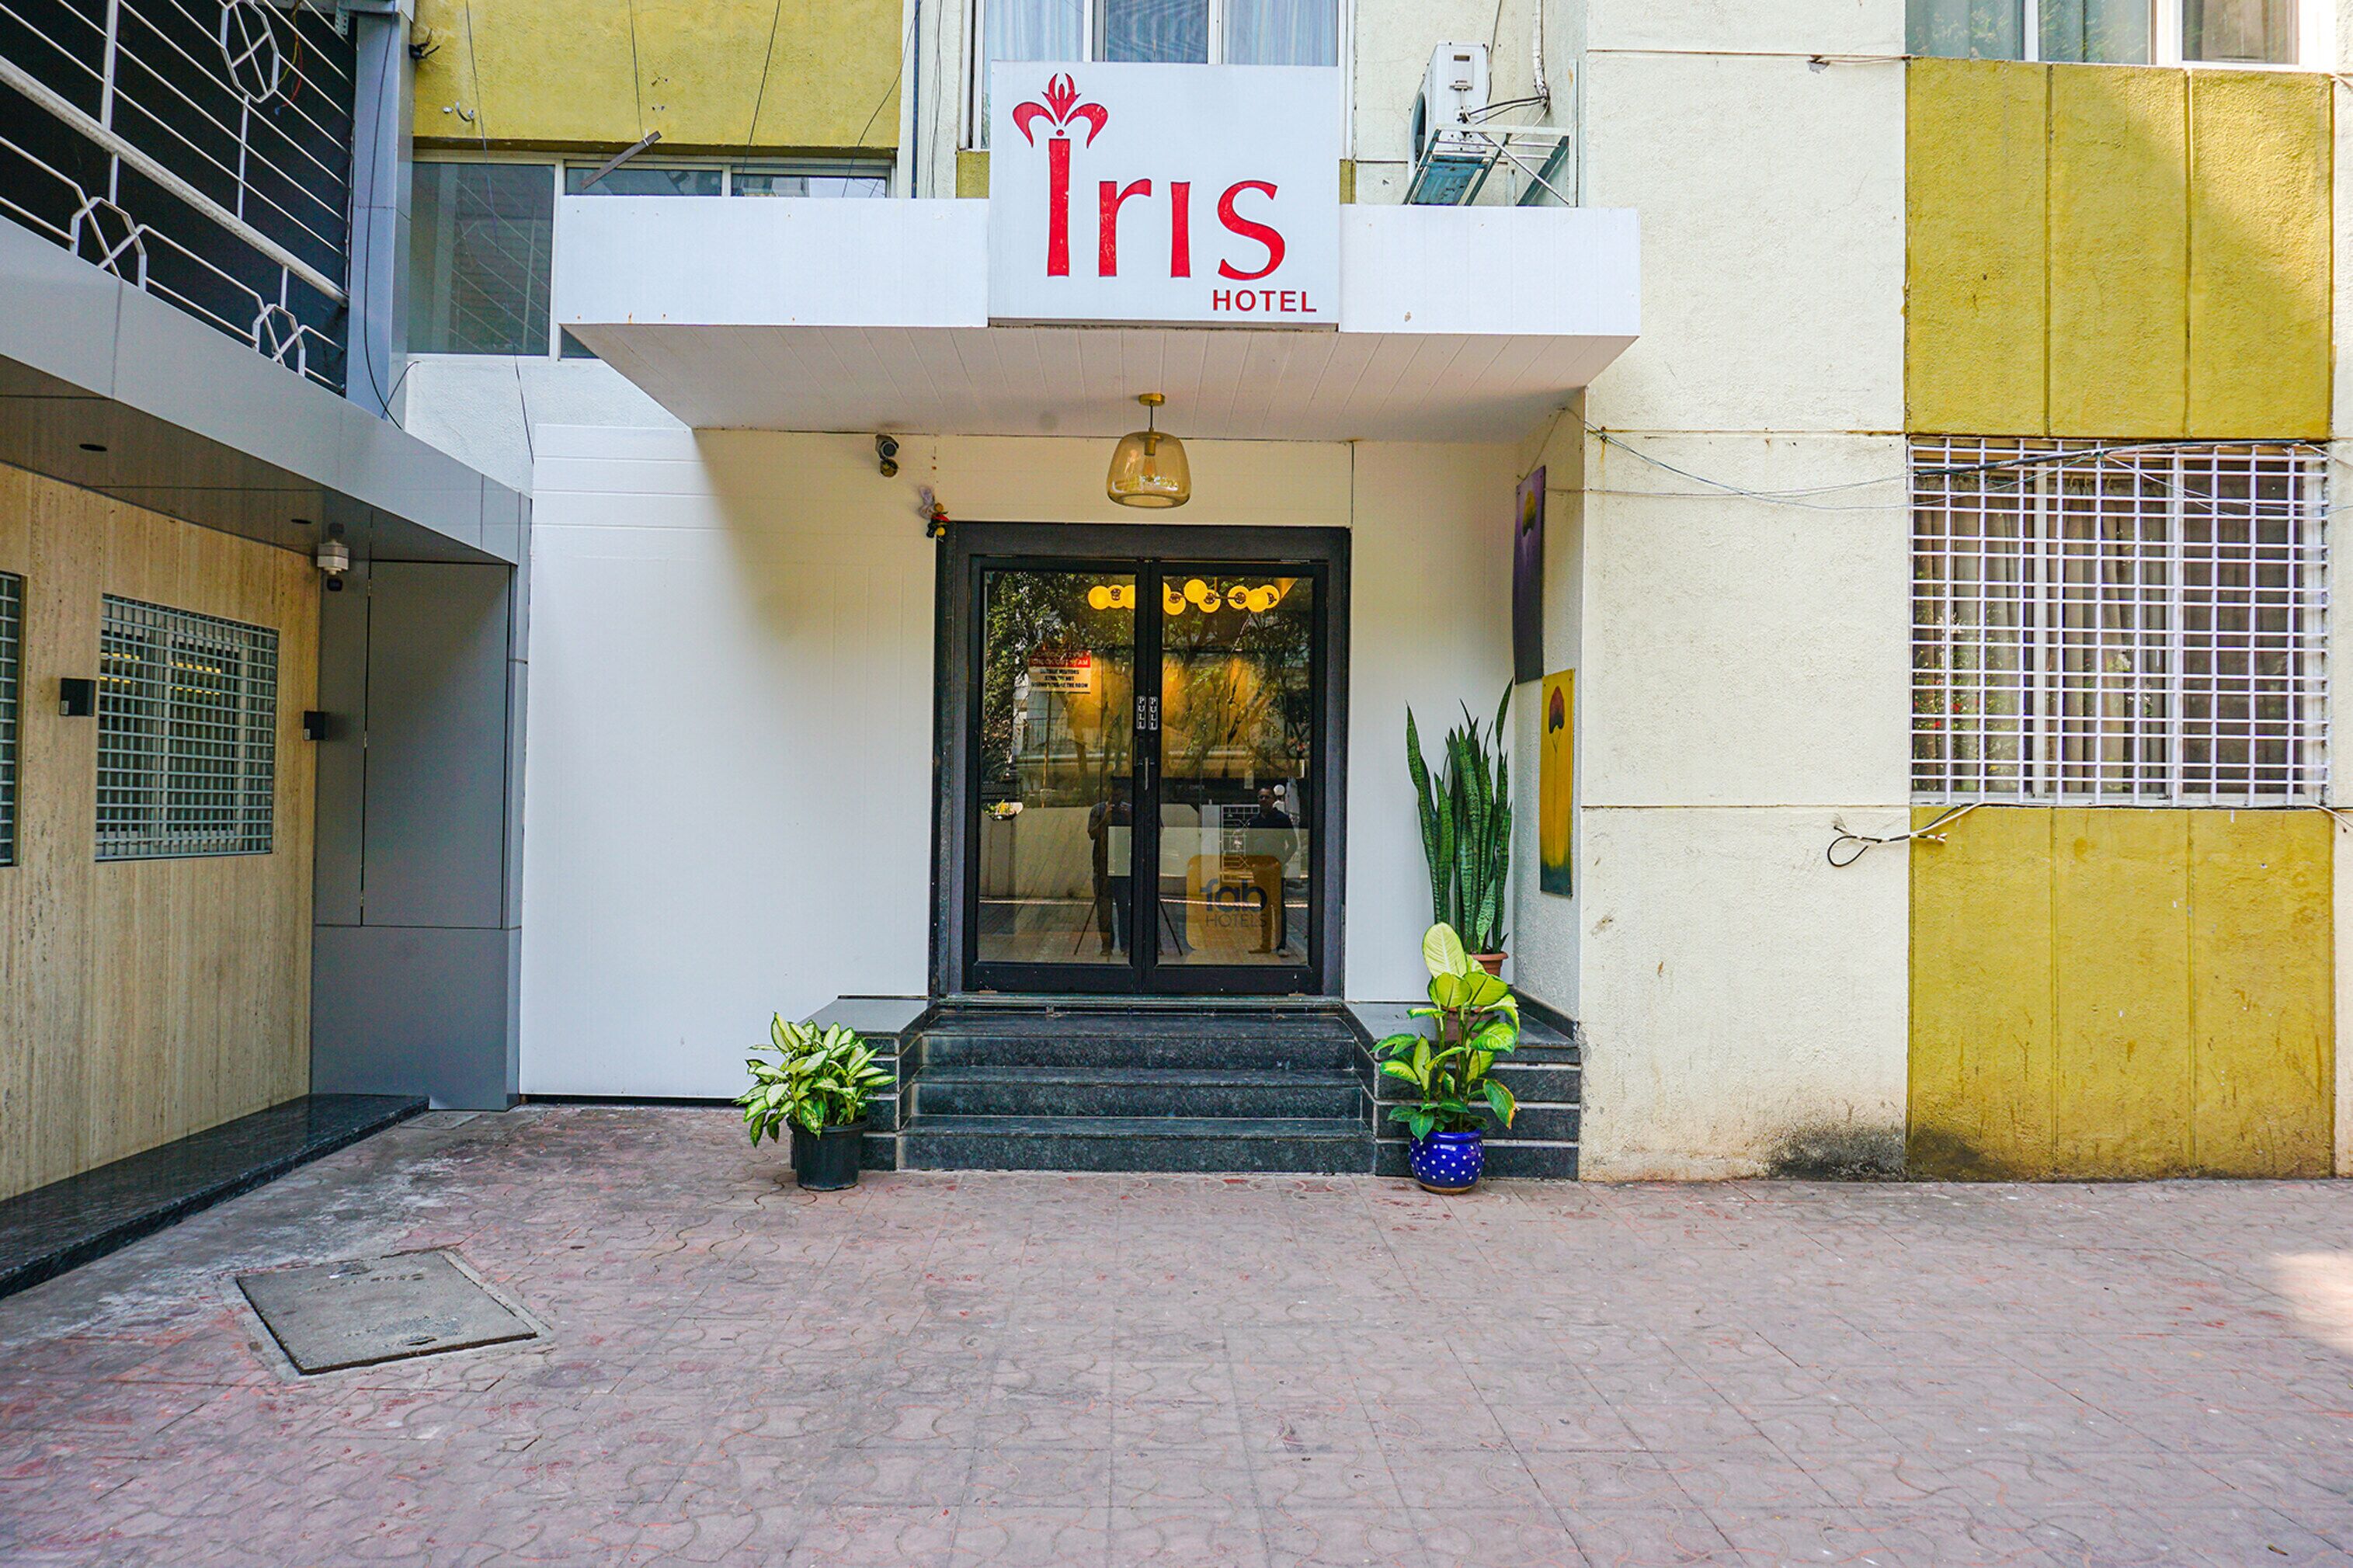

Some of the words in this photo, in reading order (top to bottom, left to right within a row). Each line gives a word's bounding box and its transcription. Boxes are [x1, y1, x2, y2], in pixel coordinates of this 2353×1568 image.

[1212, 289, 1317, 313] HOTEL
[1137, 697, 1146, 729] PULL
[1149, 697, 1158, 730] PULL
[1201, 878, 1267, 912] fab
[1206, 914, 1267, 927] HOTELS
